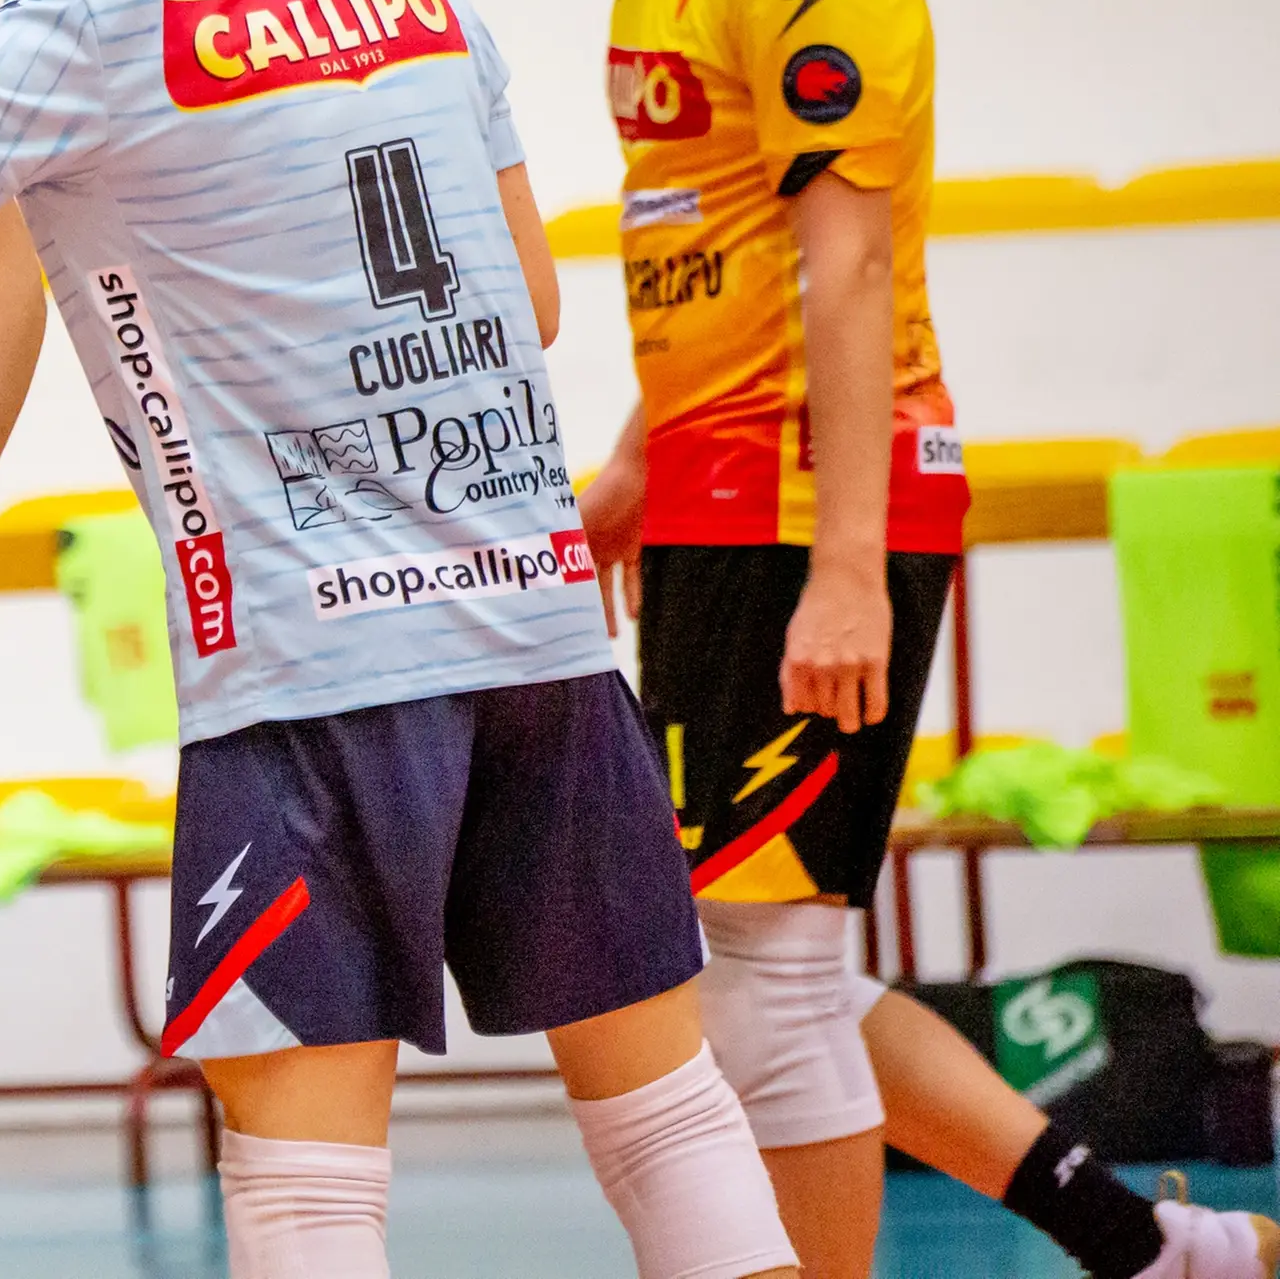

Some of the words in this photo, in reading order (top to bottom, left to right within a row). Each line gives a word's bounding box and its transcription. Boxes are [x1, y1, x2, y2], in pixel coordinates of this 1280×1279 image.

[320, 59, 351, 77] DAL
[354, 49, 386, 70] 1913
[344, 136, 461, 324] 4
[348, 316, 509, 397] CUGLIARI
[98, 270, 224, 646] shop.callipo.com
